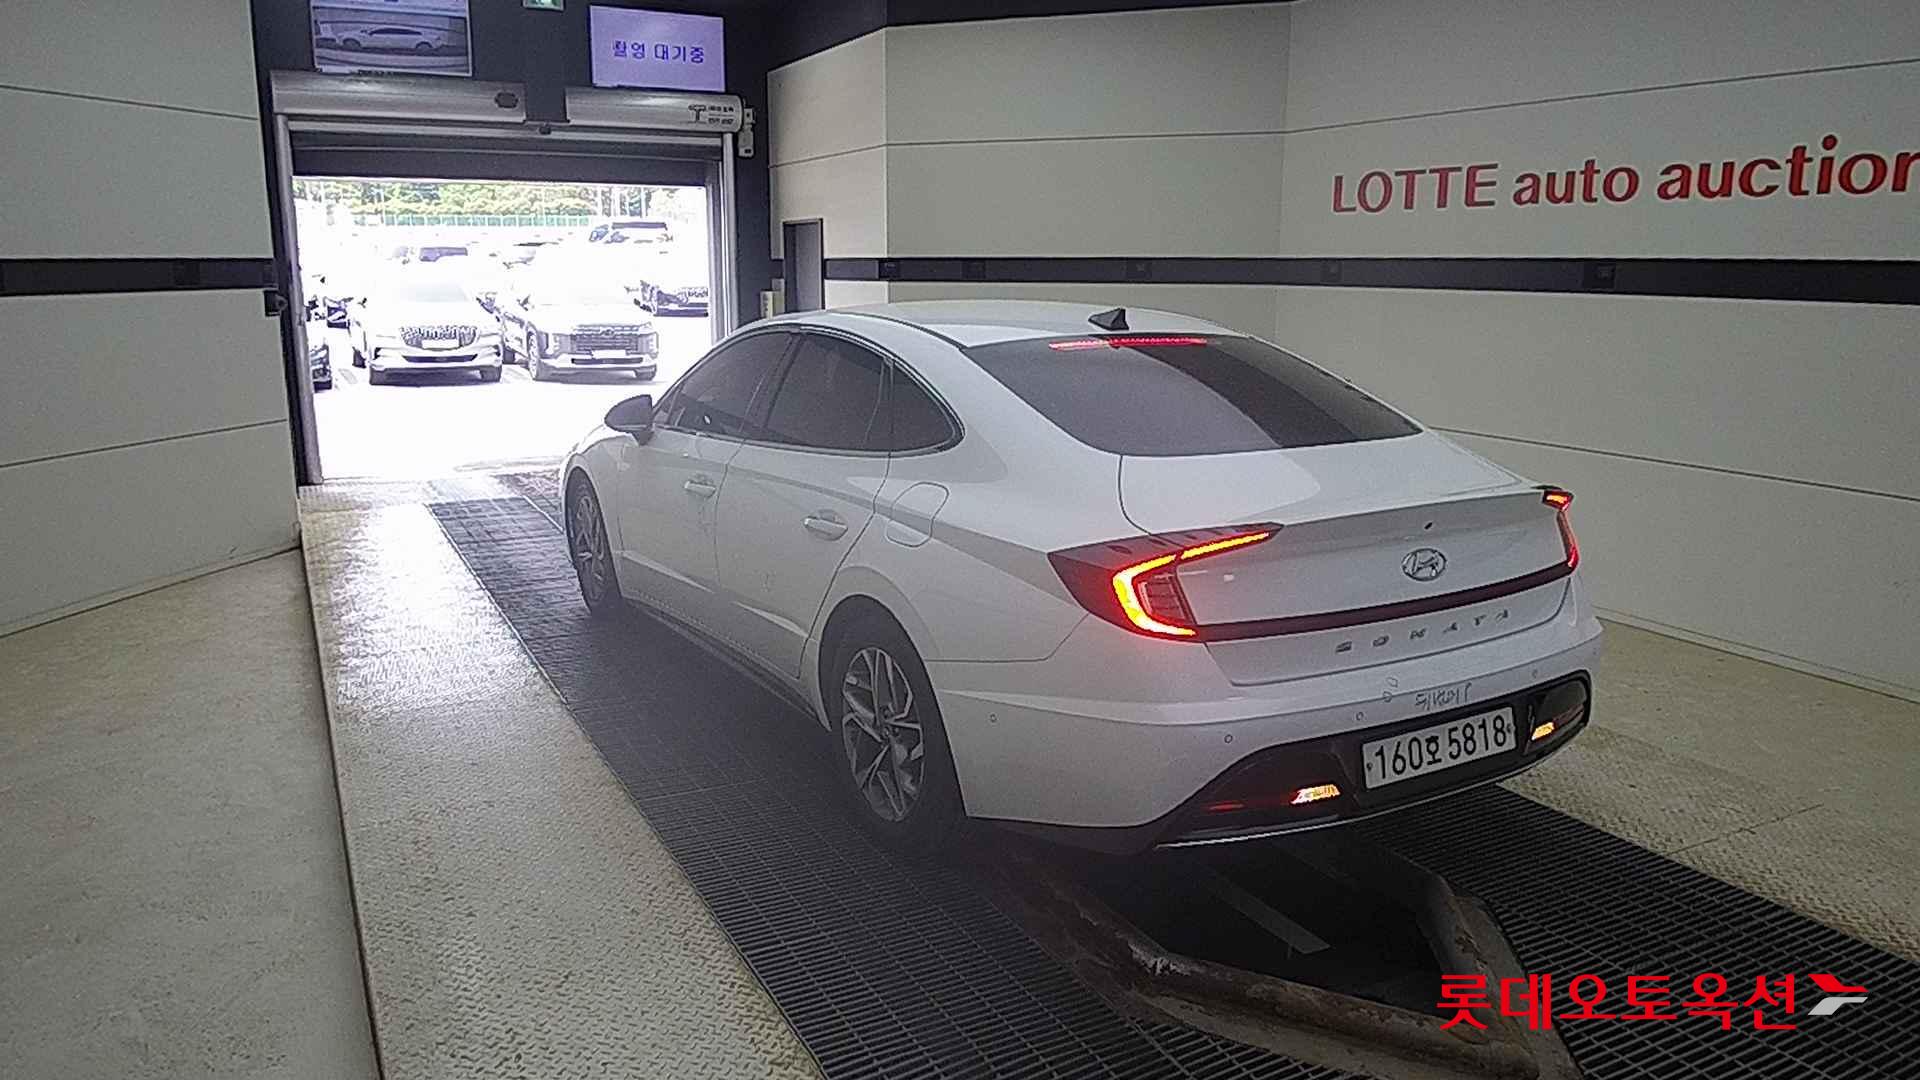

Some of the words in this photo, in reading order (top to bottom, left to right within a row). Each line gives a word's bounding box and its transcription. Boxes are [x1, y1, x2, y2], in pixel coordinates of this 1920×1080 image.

[654, 43, 704, 64] 대기중
[1333, 163, 1499, 213] LOTTE
[1512, 159, 1640, 206] auto
[1335, 609, 1510, 653] SONATA
